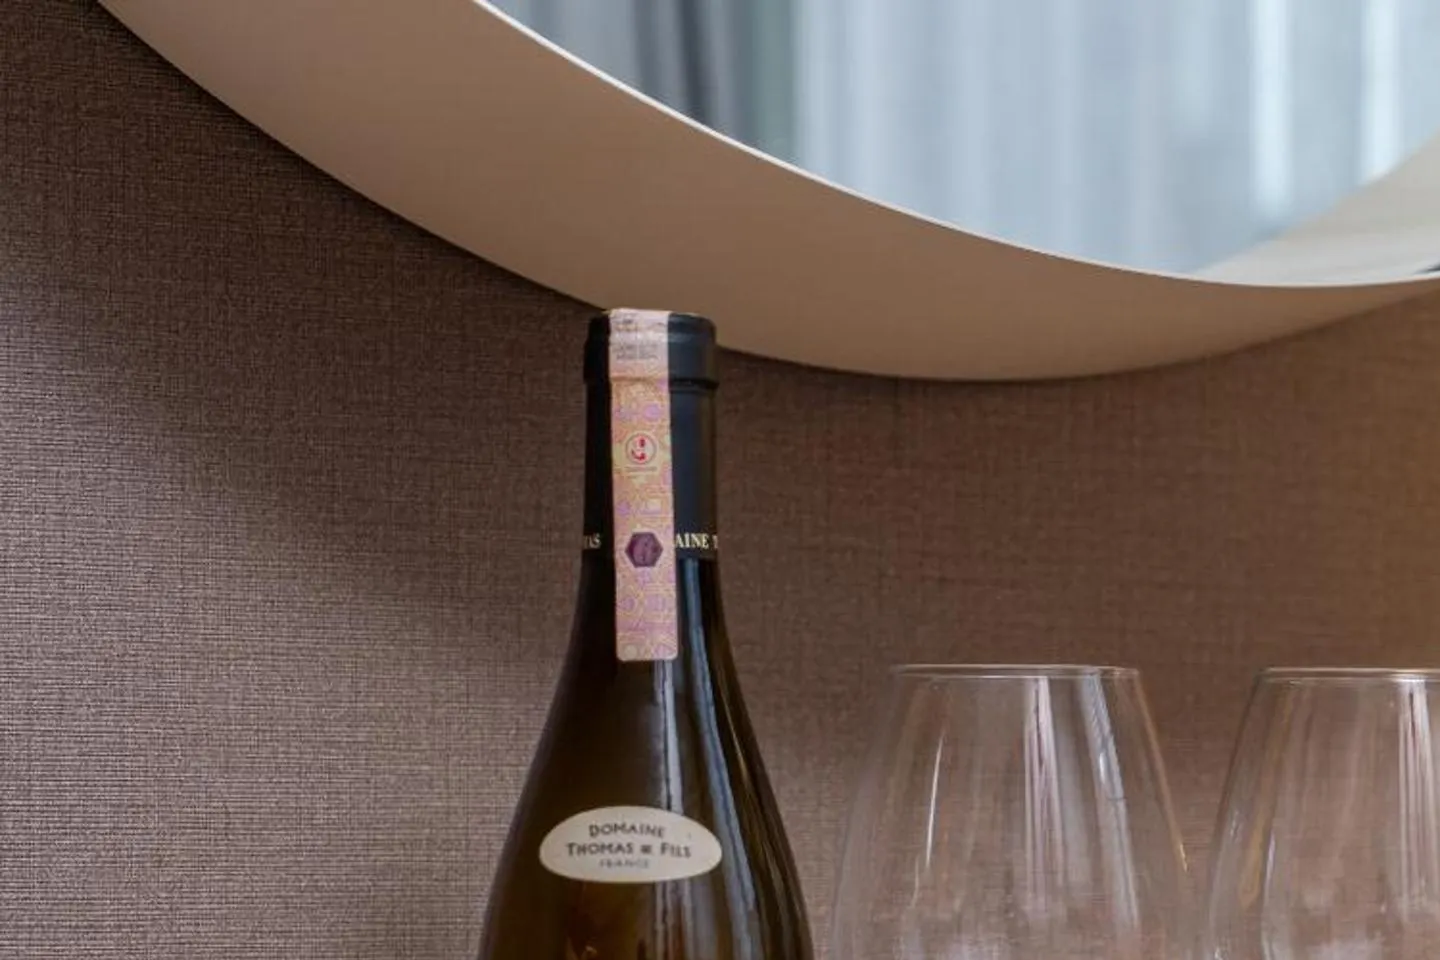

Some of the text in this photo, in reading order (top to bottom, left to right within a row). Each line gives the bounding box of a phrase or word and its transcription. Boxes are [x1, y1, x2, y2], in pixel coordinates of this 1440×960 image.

[675, 532, 710, 549] AINE
[588, 821, 667, 838] DOMAINE
[566, 841, 634, 857] THOMAS
[660, 842, 692, 859] FILS
